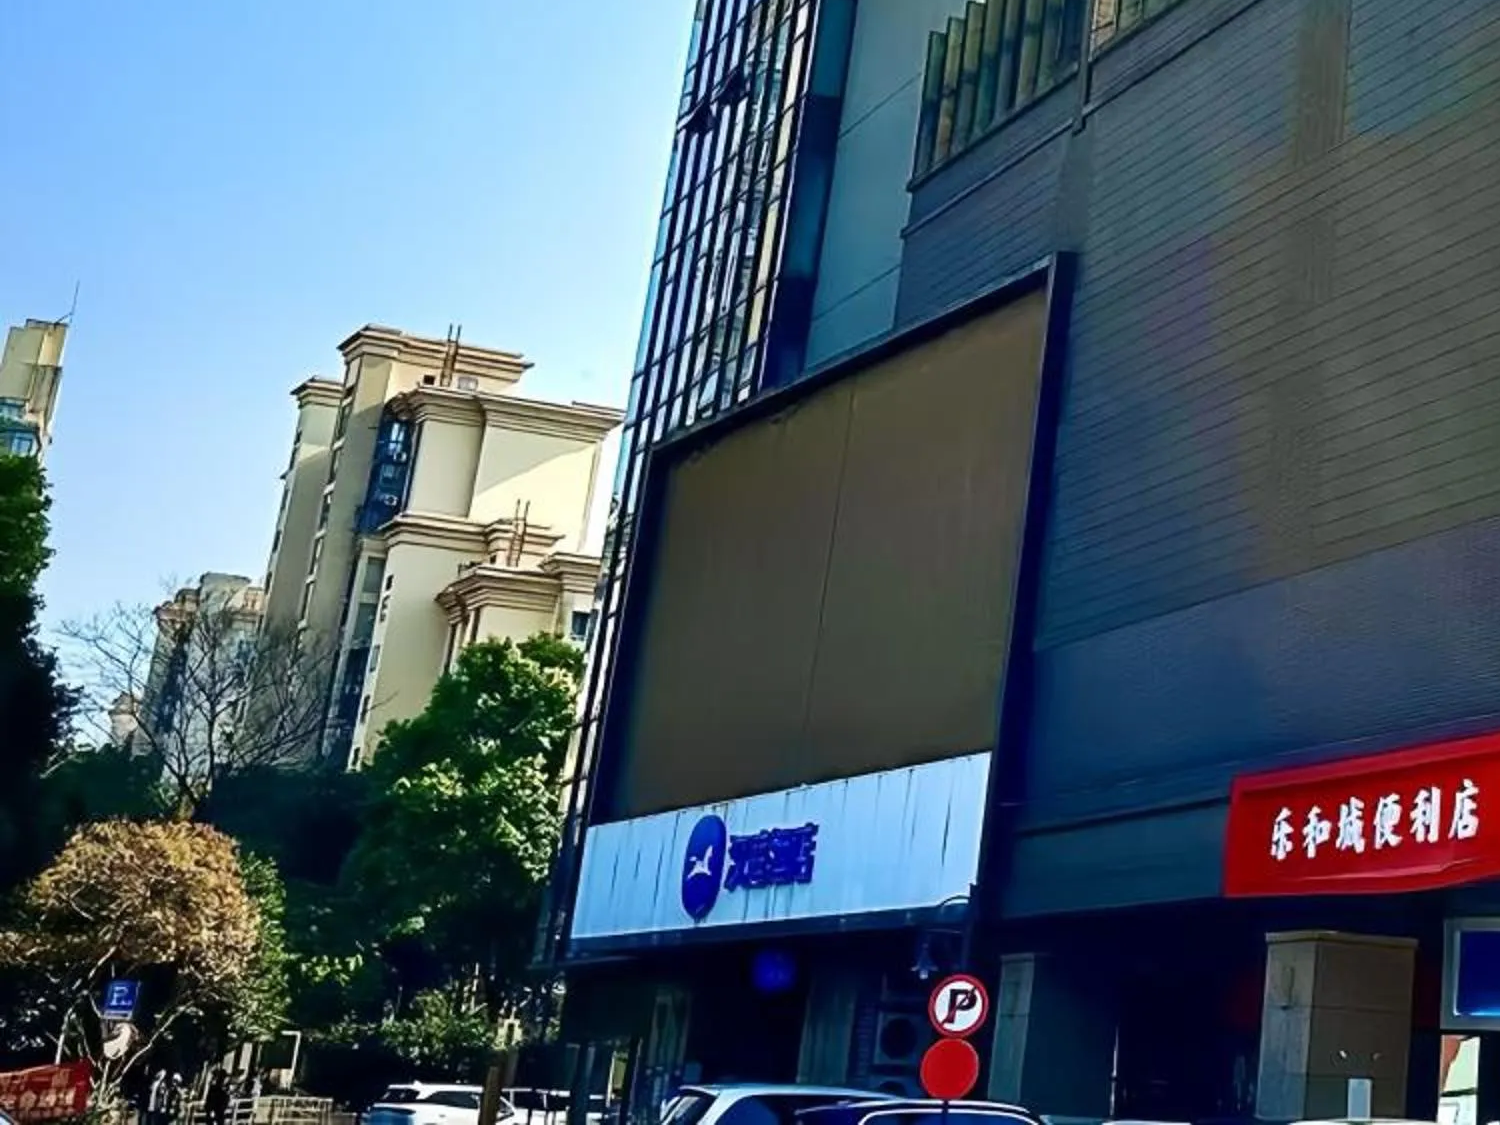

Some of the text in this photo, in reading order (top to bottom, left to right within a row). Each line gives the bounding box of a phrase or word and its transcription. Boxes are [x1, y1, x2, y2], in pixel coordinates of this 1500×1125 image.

[1270, 778, 1480, 861] 乐和城便利店
